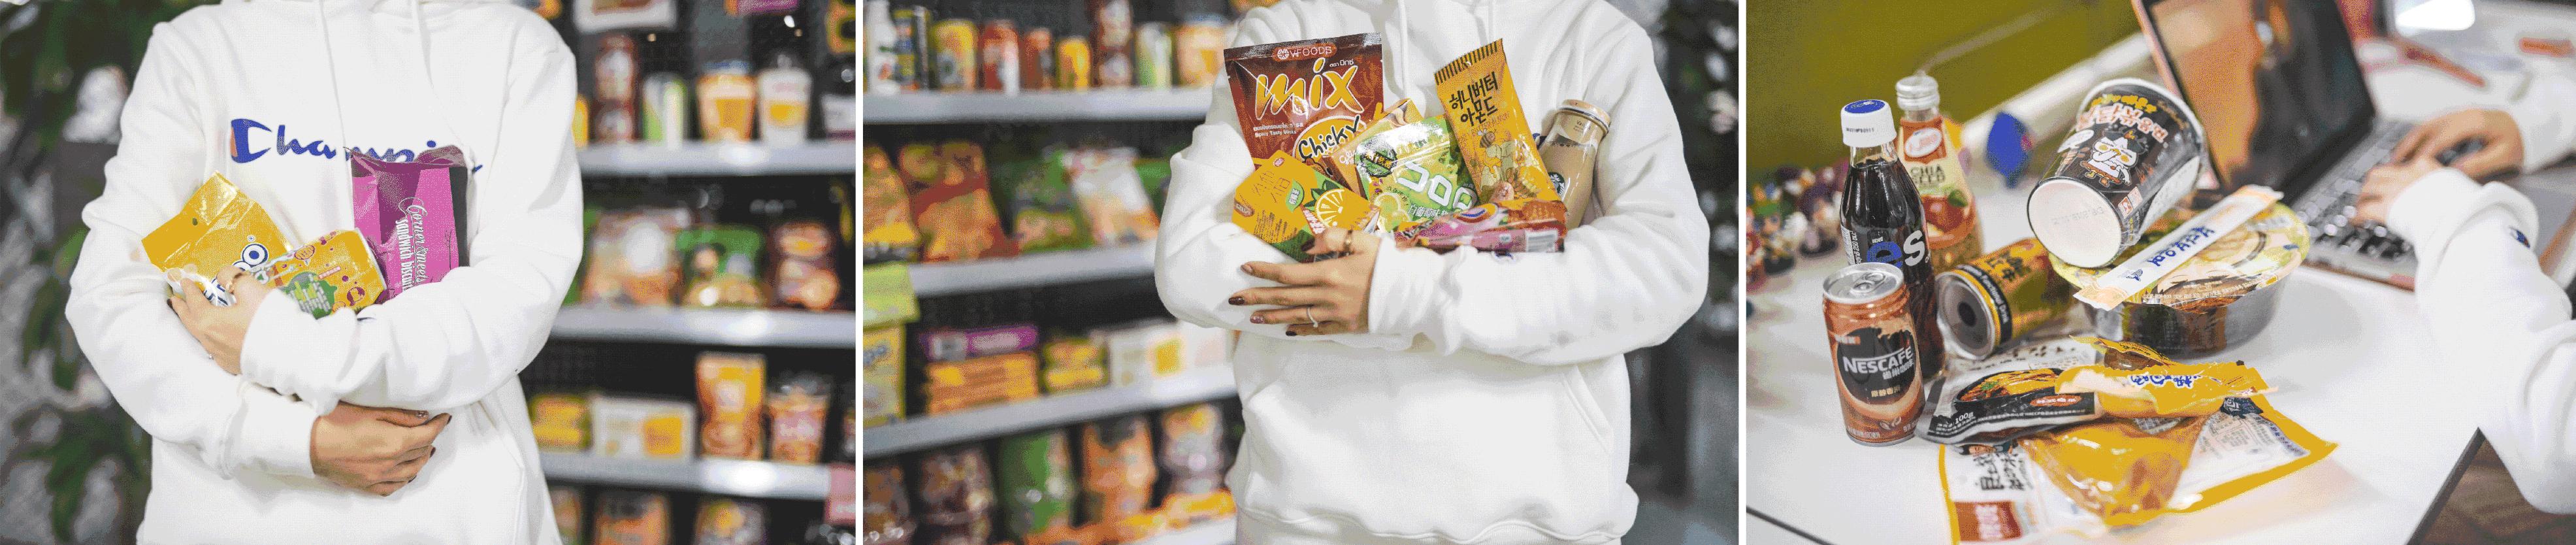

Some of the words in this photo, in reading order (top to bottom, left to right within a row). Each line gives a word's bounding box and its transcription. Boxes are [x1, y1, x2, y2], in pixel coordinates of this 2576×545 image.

[1255, 57, 1365, 120] mix
[1449, 71, 1499, 110] 허니버터
[1460, 96, 1498, 127] 아몬드
[1910, 163, 1944, 176] CHIA
[395, 219, 414, 260] sandwich
[1981, 274, 2004, 305] Functional
[1955, 412, 1974, 424] 100g
